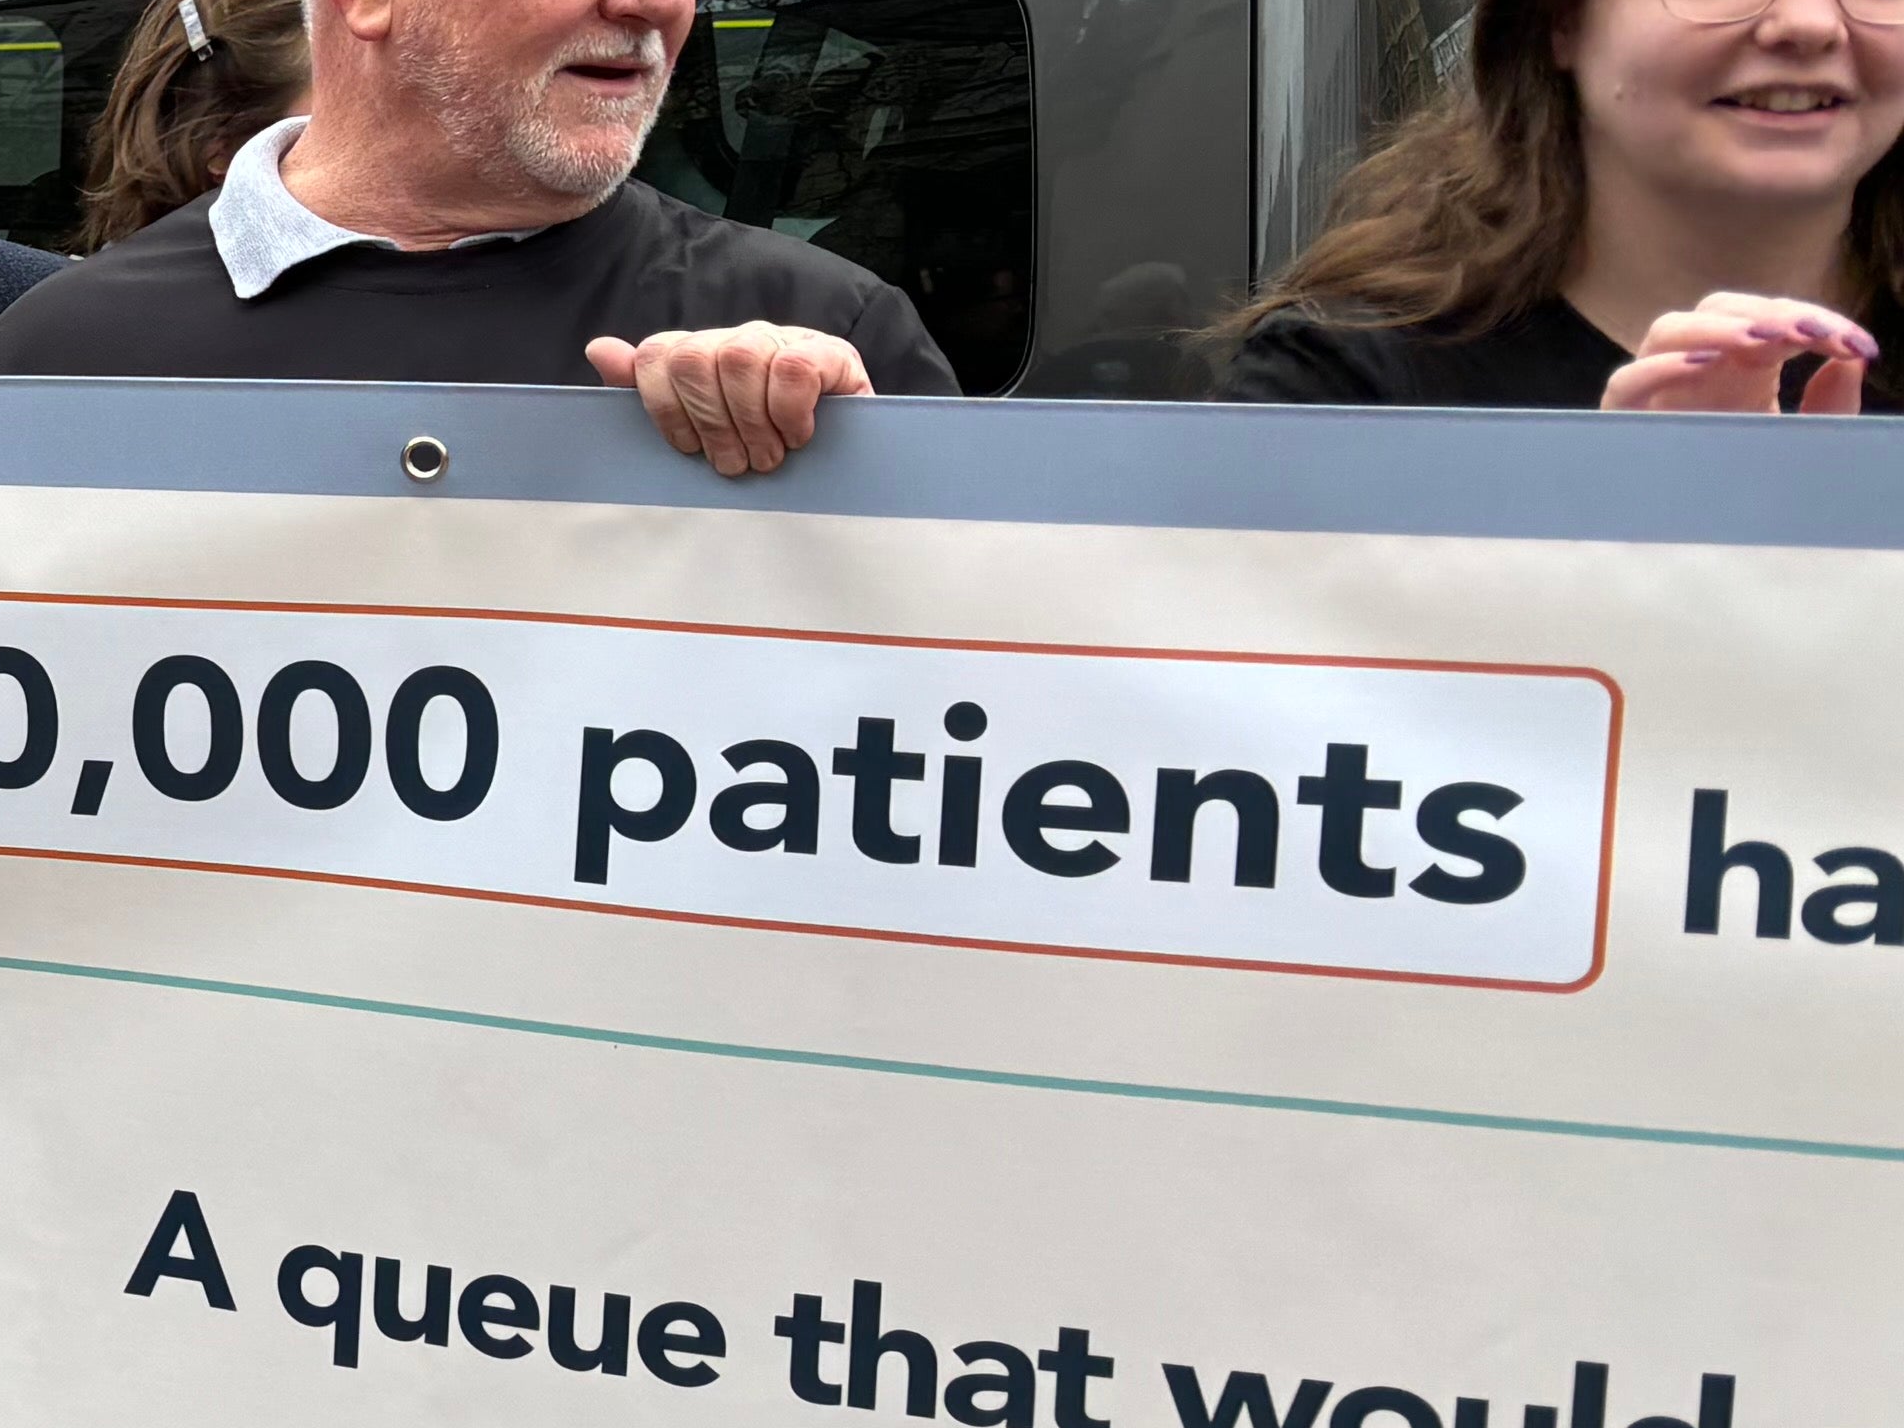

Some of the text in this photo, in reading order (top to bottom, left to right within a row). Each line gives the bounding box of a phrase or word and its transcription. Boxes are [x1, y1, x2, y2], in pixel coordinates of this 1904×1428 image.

[572, 700, 1528, 905] patients
[1682, 787, 1904, 947] ha
[123, 1189, 238, 1313] A
[276, 1243, 727, 1389] queue
